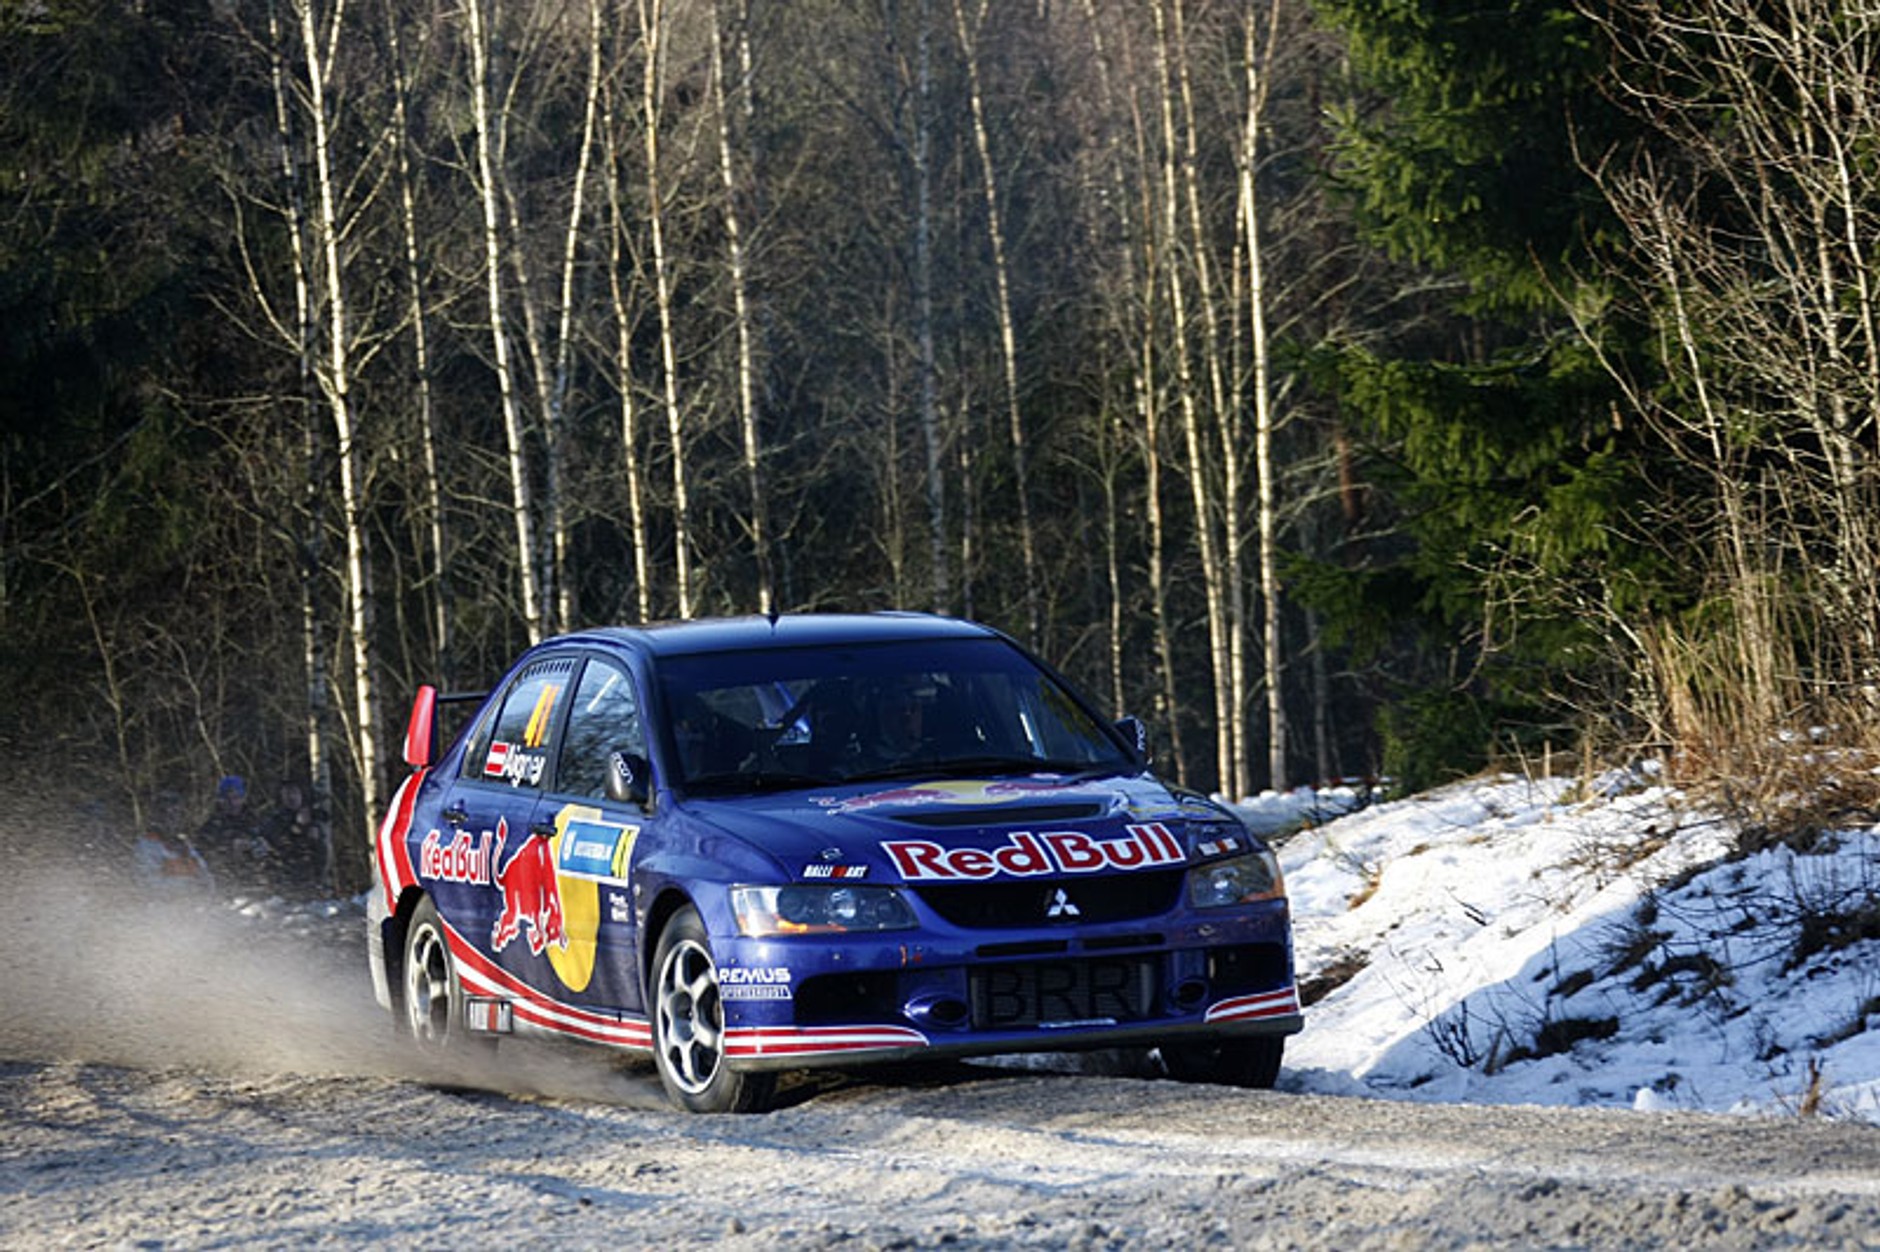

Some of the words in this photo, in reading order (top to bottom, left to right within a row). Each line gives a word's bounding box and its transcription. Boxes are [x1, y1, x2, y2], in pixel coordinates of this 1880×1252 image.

[881, 832, 1054, 879] Red
[1039, 823, 1185, 872] Bull
[720, 967, 791, 983] REMUS
[987, 960, 1137, 1023] BRR
